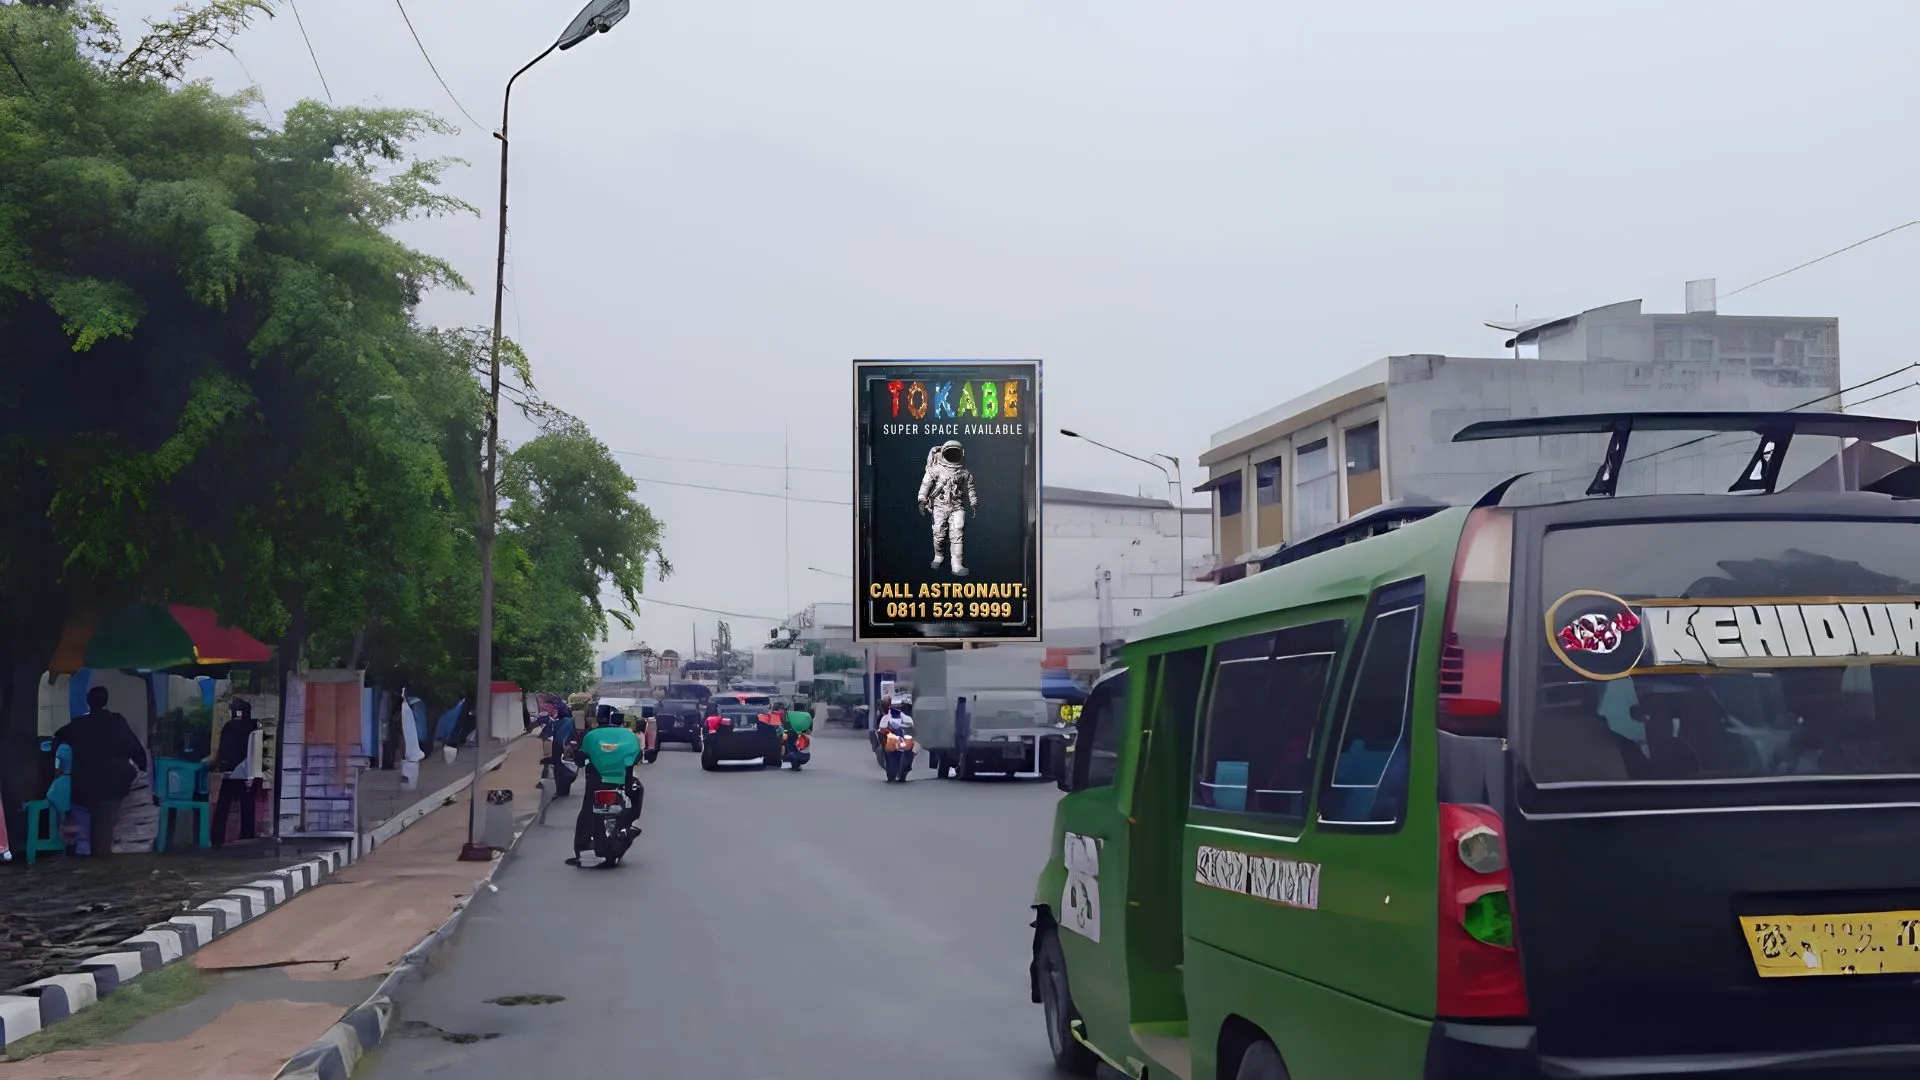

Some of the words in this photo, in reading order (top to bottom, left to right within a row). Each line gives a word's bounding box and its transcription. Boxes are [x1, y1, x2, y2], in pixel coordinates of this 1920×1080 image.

[886, 380, 1019, 419] TOKABE
[883, 424, 919, 435] SUPER
[924, 424, 959, 435] SPACE
[964, 424, 1023, 435] AVAILABLE
[870, 583, 913, 599] CALL
[918, 583, 1028, 599] ASTRONAUT:
[886, 602, 927, 618] 0811
[932, 602, 965, 618] 523
[969, 602, 1012, 618] 9999
